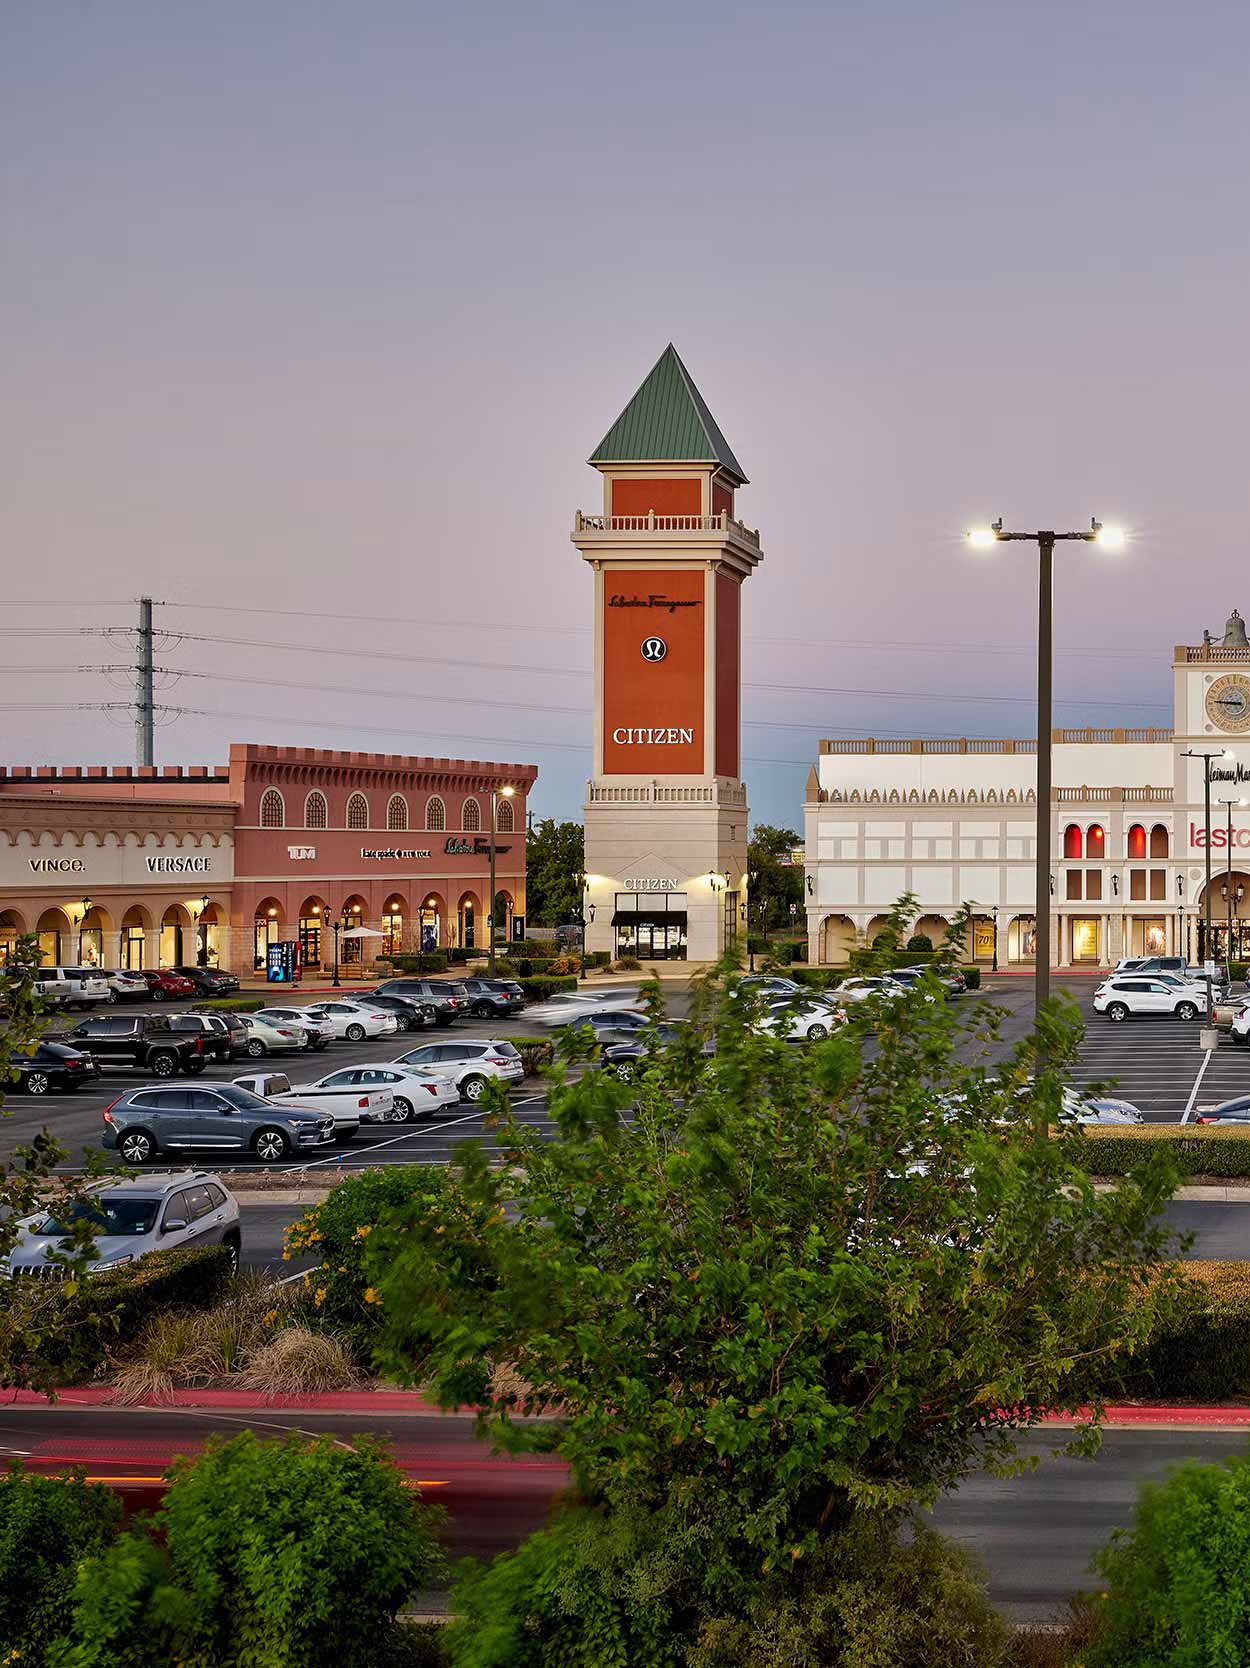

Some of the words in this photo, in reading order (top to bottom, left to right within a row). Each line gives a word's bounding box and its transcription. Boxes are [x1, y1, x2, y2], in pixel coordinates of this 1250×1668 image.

[613, 728, 694, 745] CITIZEN
[147, 857, 211, 872] VERSACE
[624, 878, 678, 890] CITIZEN
